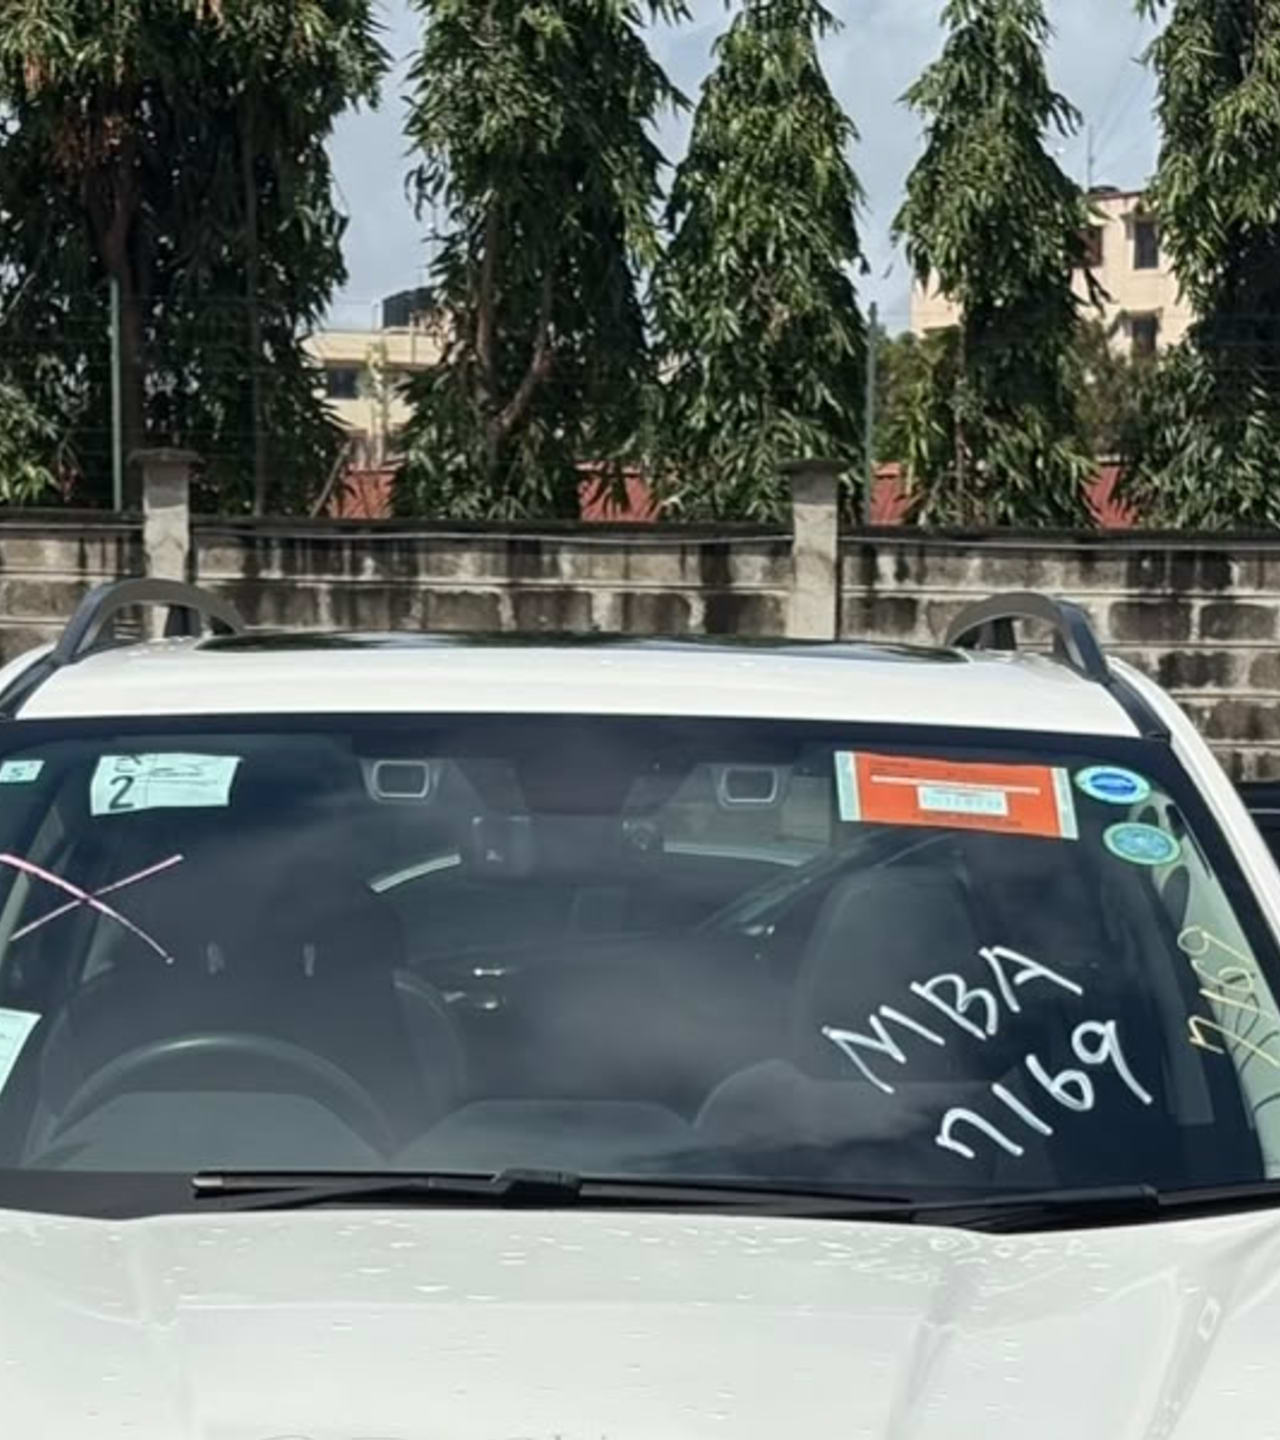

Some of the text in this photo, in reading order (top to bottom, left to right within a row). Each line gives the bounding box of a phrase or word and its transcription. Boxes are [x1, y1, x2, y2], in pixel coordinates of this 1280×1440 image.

[108, 775, 137, 811] 2
[820, 944, 1085, 1095] MBA
[934, 1019, 1154, 1160] 7169
